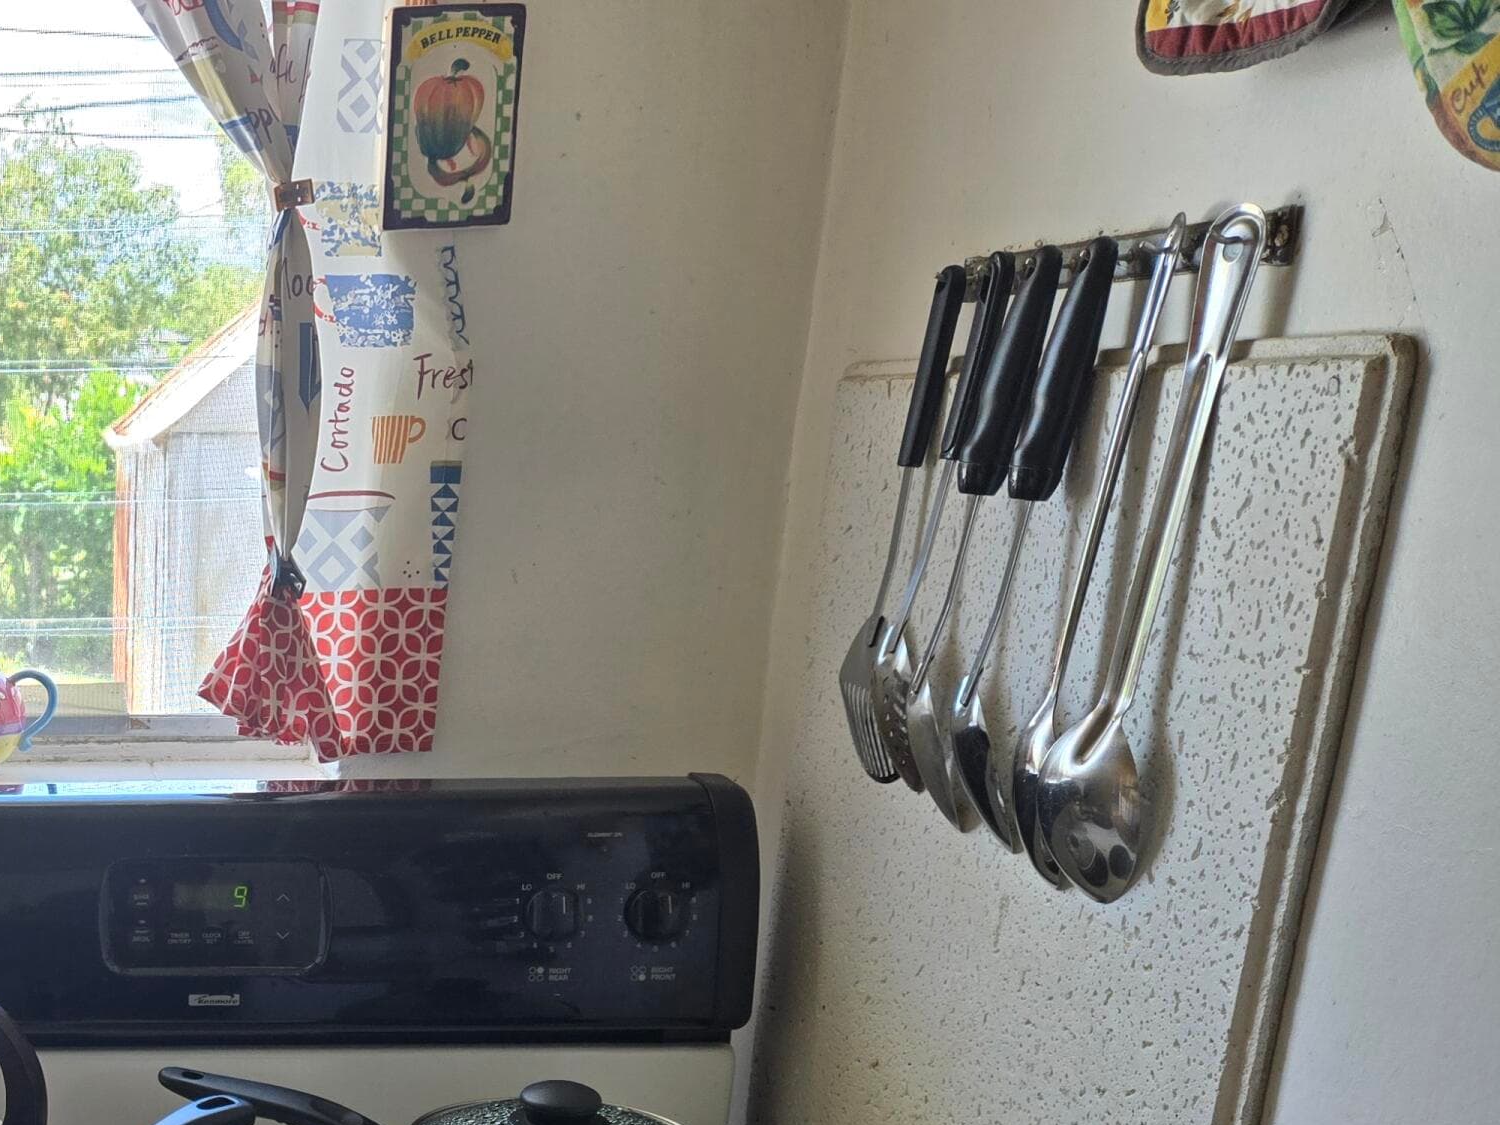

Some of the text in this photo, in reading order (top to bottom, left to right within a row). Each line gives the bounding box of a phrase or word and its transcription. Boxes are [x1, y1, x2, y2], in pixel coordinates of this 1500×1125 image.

[420, 26, 502, 49] BELL PEPPER
[320, 366, 356, 472] Cortado
[521, 883, 533, 891] LO
[625, 882, 636, 890] LO
